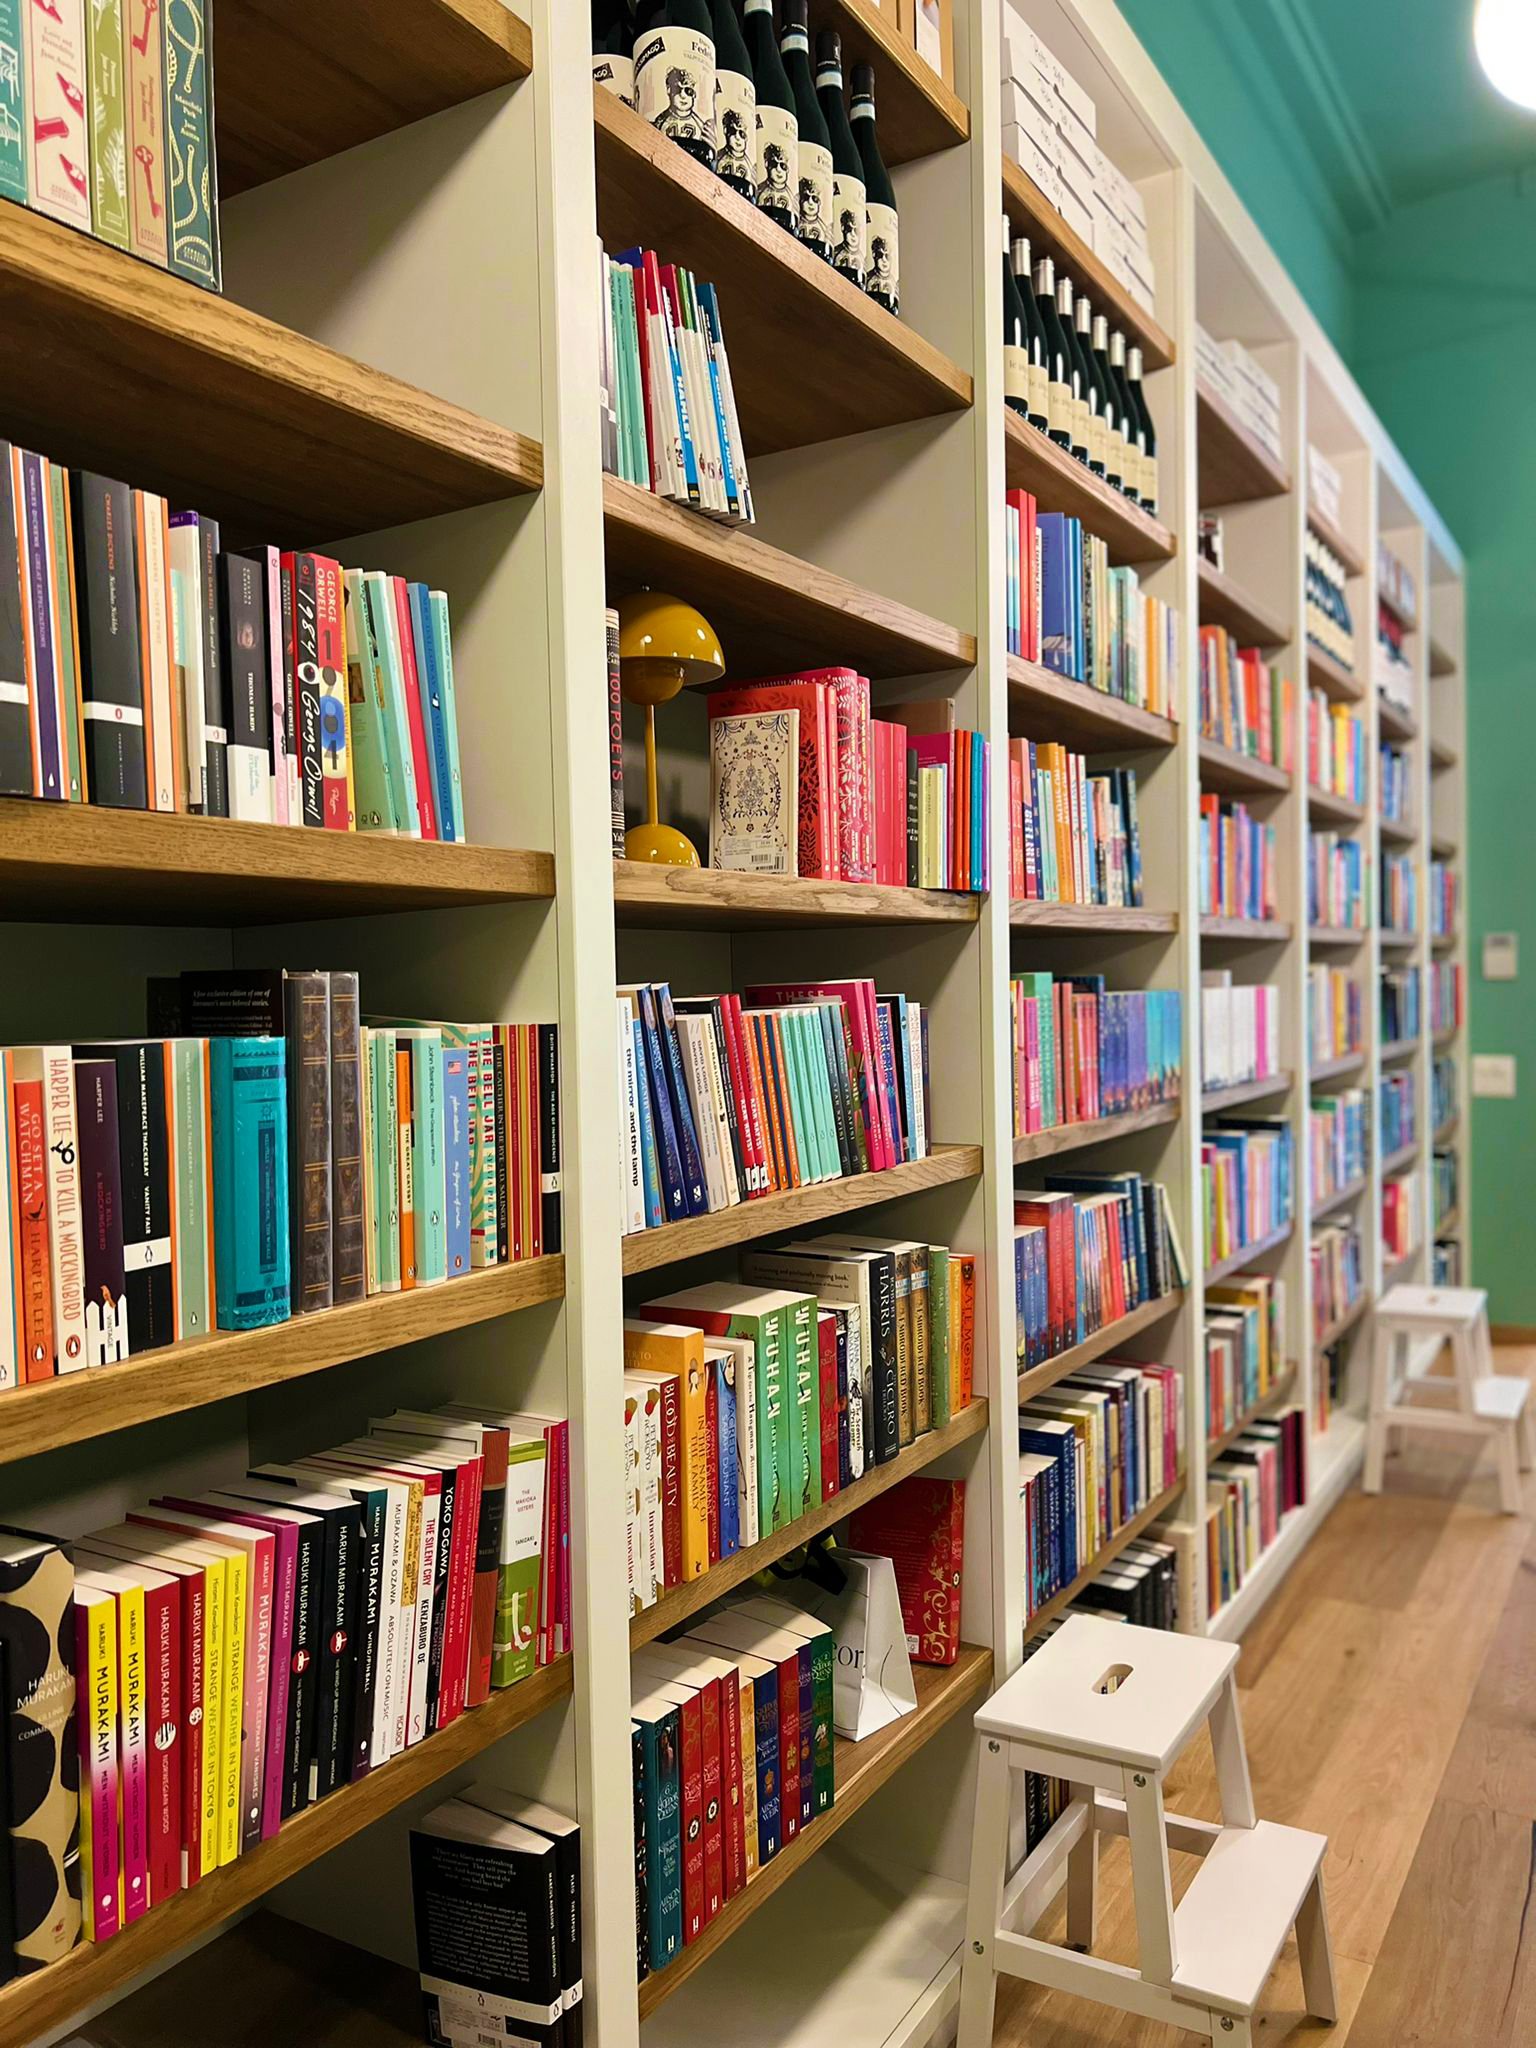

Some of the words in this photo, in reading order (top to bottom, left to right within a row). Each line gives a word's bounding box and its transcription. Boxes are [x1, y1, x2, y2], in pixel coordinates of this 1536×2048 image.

[316, 567, 326, 619] ORWELL
[327, 570, 337, 623] GEORGE
[298, 589, 317, 657] 1984
[610, 672, 621, 704] 100
[302, 690, 320, 753] George
[611, 711, 624, 783] POETS
[304, 756, 322, 820] Orwell
[482, 1038, 493, 1066] THE
[49, 1058, 70, 1110] HARPER
[483, 1073, 493, 1107] BELL
[627, 1070, 635, 1108] mirror
[701, 1065, 709, 1094] LODGE
[833, 1082, 841, 1105] AZAR
[32, 1113, 41, 1138] GO
[53, 1114, 72, 1134] LEE
[140, 1084, 148, 1129] MAKEPEACE
[836, 1109, 845, 1142] NAFISI
[484, 1115, 495, 1144] JAR
[630, 1135, 638, 1154] the
[744, 1123, 753, 1152] NAFISI
[20, 1103, 33, 1203] WATCHMAN
[32, 1144, 42, 1173] SET
[631, 1158, 640, 1186] lamp
[33, 1180, 43, 1190] A
[55, 1167, 74, 1183] TO
[56, 1187, 76, 1216] KILL
[58, 1220, 76, 1229] A
[30, 1232, 43, 1301] HARPER
[59, 1232, 82, 1321] MOCKINGBIRD
[880, 1264, 890, 1338] HARRIS
[965, 1281, 973, 1323] KATE
[33, 1308, 45, 1336] LEE
[795, 1305, 812, 1407] WUHAN
[853, 1329, 861, 1363] DIANA
[963, 1329, 972, 1386] MOSSE
[766, 1316, 781, 1419] WUHAN
[665, 1383, 677, 1437] BLOOD
[886, 1368, 897, 1436] CICERO
[900, 1387, 908, 1417] BOOK
[698, 1415, 705, 1431] IN
[728, 1398, 737, 1456] SACRED
[698, 1434, 706, 1459] THE
[666, 1444, 676, 1506] BEAUTY
[730, 1462, 738, 1521] HEARTS
[444, 1486, 454, 1523] YOKO
[515, 1495, 537, 1505] MAKIOKA
[517, 1503, 535, 1512] SISTERS
[373, 1506, 381, 1537] HARUKI
[392, 1504, 402, 1557] MURAKAMI
[425, 1518, 435, 1537] THE
[515, 1535, 535, 1546] TANIZAKI
[300, 1541, 310, 1584] HARUKI
[338, 1526, 348, 1566] HARUKI
[424, 1539, 434, 1568] SILENT
[439, 1527, 450, 1578] OGAWA
[262, 1554, 270, 1588] HARUKI
[284, 1557, 292, 1588] HARUKI
[367, 1543, 380, 1625] MURAKAMI
[389, 1570, 398, 1605] OZAWA
[423, 1570, 432, 1586] CRY
[192, 1592, 202, 1636] HARUKI
[282, 1590, 291, 1638] MURAKAMI
[298, 1584, 308, 1645] MURAKAMI
[336, 1567, 346, 1627] MURAKAMI
[98, 1623, 106, 1660] HARUKI
[129, 1609, 137, 1645] HARUKI
[160, 1606, 171, 1650] HARUKI
[256, 1594, 271, 1683] MURAKAMI
[386, 1615, 395, 1671] ABSOLUTELY
[418, 1599, 429, 1650] KENZABURO
[28, 1665, 69, 1691] HARUKI
[191, 1639, 202, 1703] MURAKAMI
[208, 1650, 218, 1702] STRANGE
[230, 1640, 240, 1692] STRANGE
[364, 1631, 373, 1693] WIND/PINBALL
[417, 1653, 426, 1665] OE
[127, 1652, 140, 1747] MURAKAMI
[160, 1653, 171, 1719] MURAKAMI
[385, 1674, 392, 1689] ON
[96, 1666, 110, 1763] MURAKAMI
[229, 1694, 239, 1748] WEATHER
[383, 1690, 391, 1721] MUSIC
[208, 1705, 217, 1758] WEATHER
[396, 1715, 404, 1746] PICADOR
[730, 1736, 736, 1749] OF
[208, 1761, 216, 1775] IN
[229, 1751, 237, 1764] IN
[252, 1755, 260, 1799] VANISHES
[206, 1777, 216, 1819] TOKYO
[227, 1767, 237, 1809] TOKYO
[660, 1886, 681, 1910] ALISON
[662, 1899, 680, 1915] WEIR
